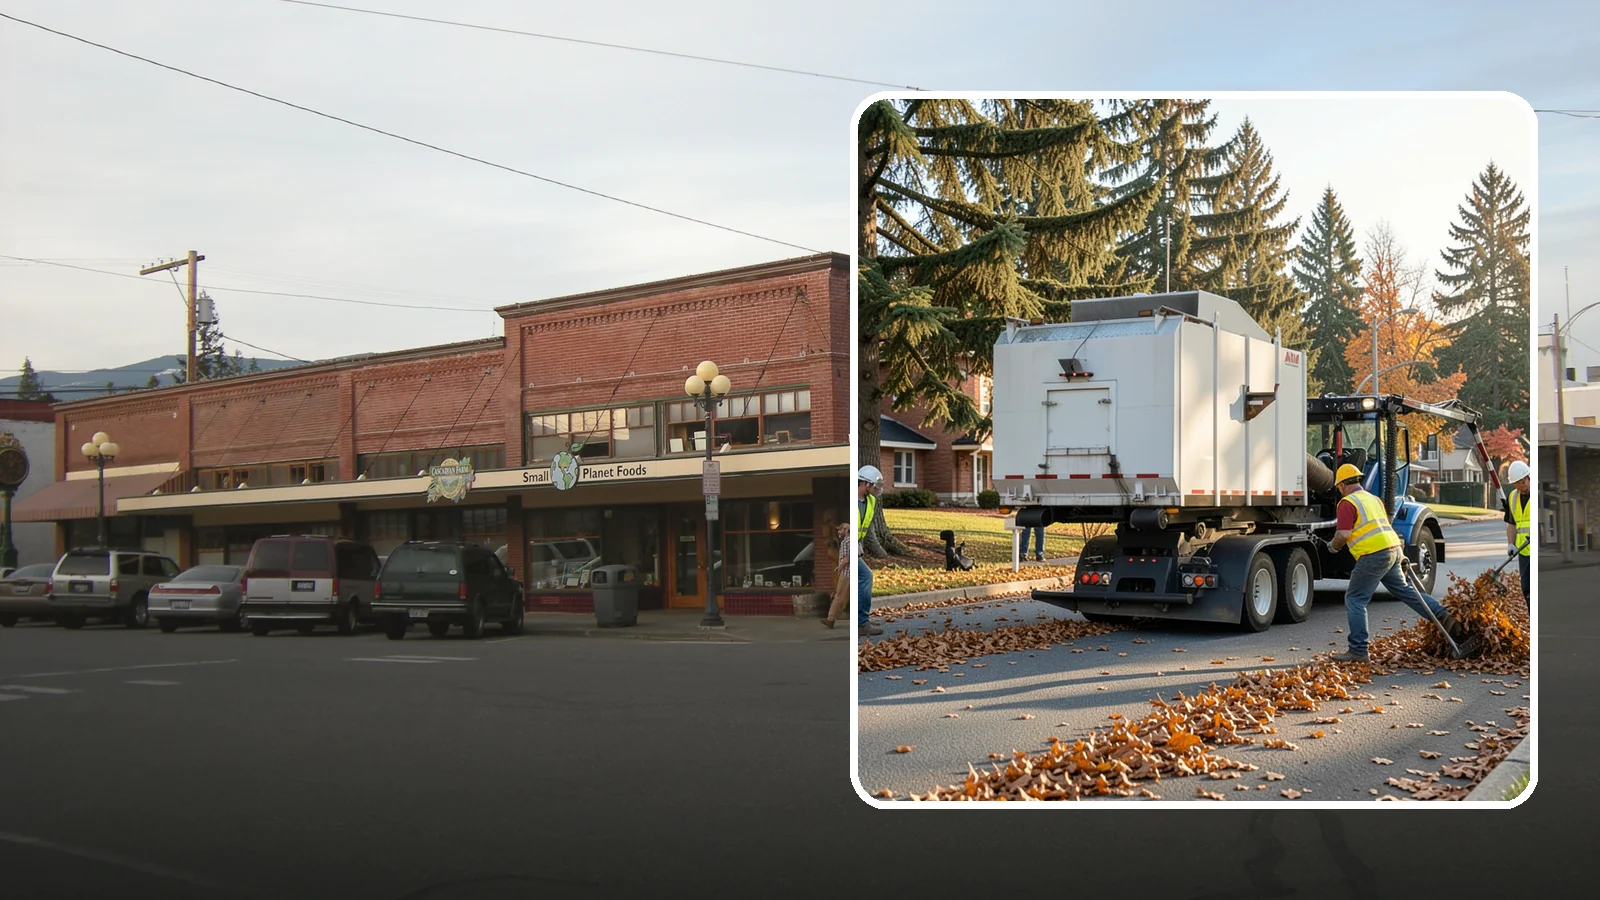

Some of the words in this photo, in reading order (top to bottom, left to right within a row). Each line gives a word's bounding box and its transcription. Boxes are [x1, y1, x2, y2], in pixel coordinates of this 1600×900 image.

[522, 470, 549, 483] Small
[582, 467, 614, 479] Planet
[616, 464, 647, 477] Foods
